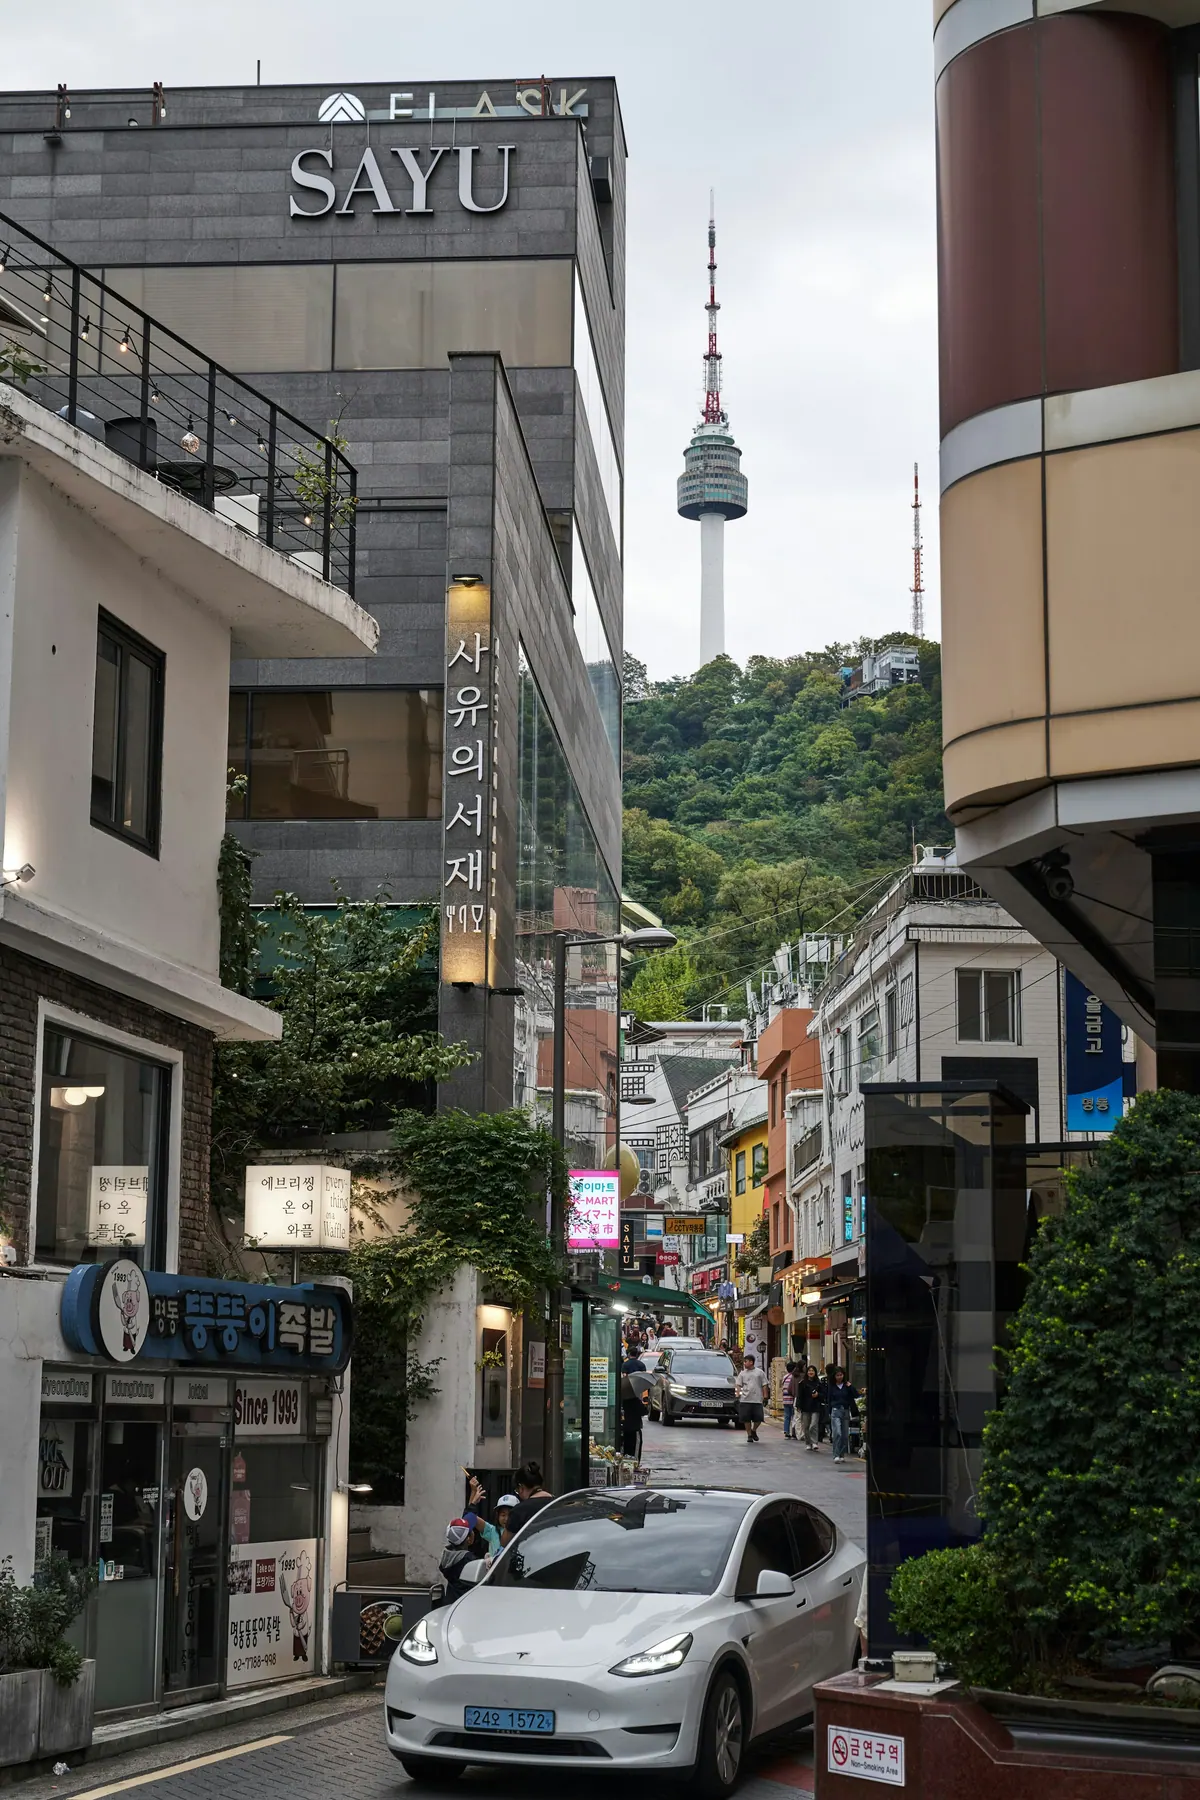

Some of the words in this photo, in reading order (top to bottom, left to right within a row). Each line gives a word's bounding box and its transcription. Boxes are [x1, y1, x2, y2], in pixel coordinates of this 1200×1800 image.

[289, 145, 516, 218] SAYU
[1082, 1097, 1109, 1111] 명동
[261, 1176, 315, 1192] 에브리씽
[282, 1200, 296, 1215] 온
[301, 1200, 314, 1215] 어
[573, 1196, 615, 1206] K-MART
[574, 1209, 615, 1220] ケイマート
[287, 1223, 314, 1239] 와플
[323, 1220, 346, 1239] Waffle
[623, 1224, 631, 1264] SAYU
[113, 1272, 127, 1283] 1993
[155, 1299, 179, 1335] 명동
[234, 1388, 269, 1426] Since
[272, 1389, 299, 1425] 1993
[40, 1438, 63, 1463] AKE
[43, 1465, 69, 1490] OUT
[256, 1563, 268, 1573] Take
[281, 1559, 296, 1572] 1993
[472, 1710, 500, 1726] 24오
[508, 1712, 545, 1729] 1572
[850, 1738, 898, 1764] 금연구역
[850, 1759, 885, 1774] Non-Smoking
[886, 1766, 898, 1776] Area
